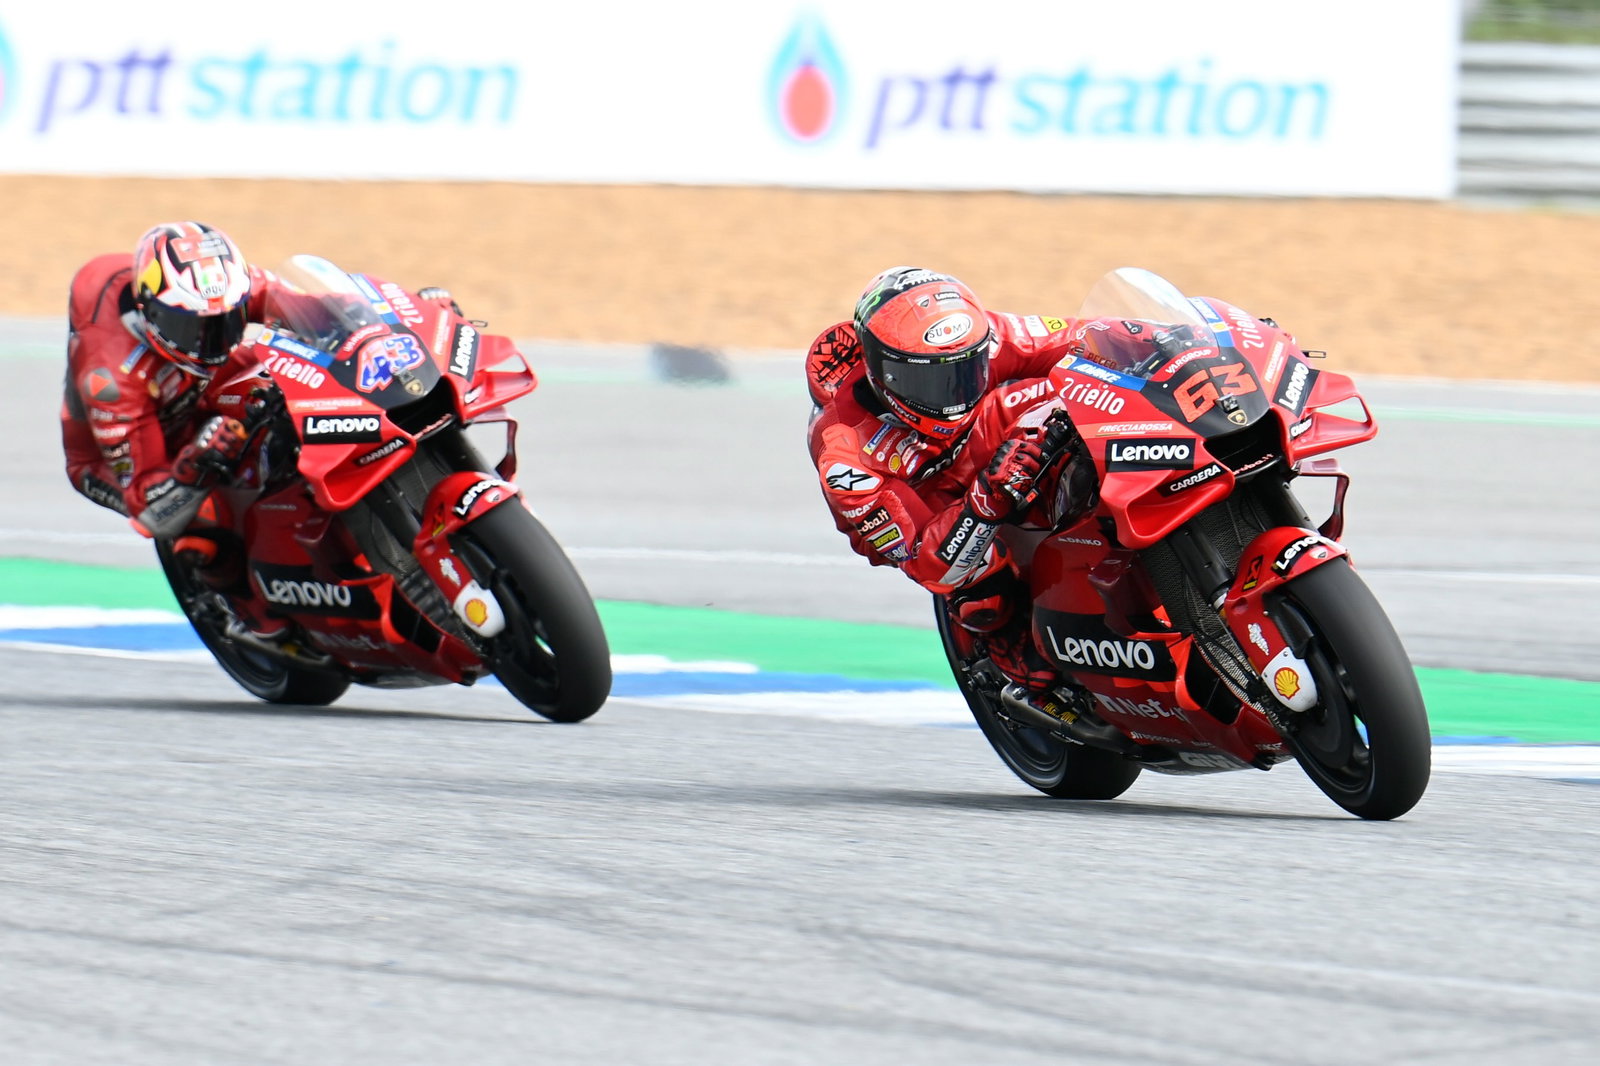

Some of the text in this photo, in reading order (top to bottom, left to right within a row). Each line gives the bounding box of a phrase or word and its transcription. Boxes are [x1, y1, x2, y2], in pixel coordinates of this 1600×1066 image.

[33, 40, 520, 135] ptt station
[863, 60, 1331, 149] ptt station
[450, 325, 476, 376] Lenovo
[1172, 361, 1258, 423] 63
[1278, 362, 1310, 412] Lenovo
[306, 417, 380, 434] Lenovo
[1098, 423, 1173, 433] FRECCIAROSSA
[359, 438, 405, 466] CARRERA
[1111, 443, 1190, 462] Lenovo
[1169, 464, 1222, 493] CARRERA
[941, 517, 974, 561] Lenovo
[255, 570, 351, 607] Lenovo
[1046, 626, 1156, 671] Lenovo
